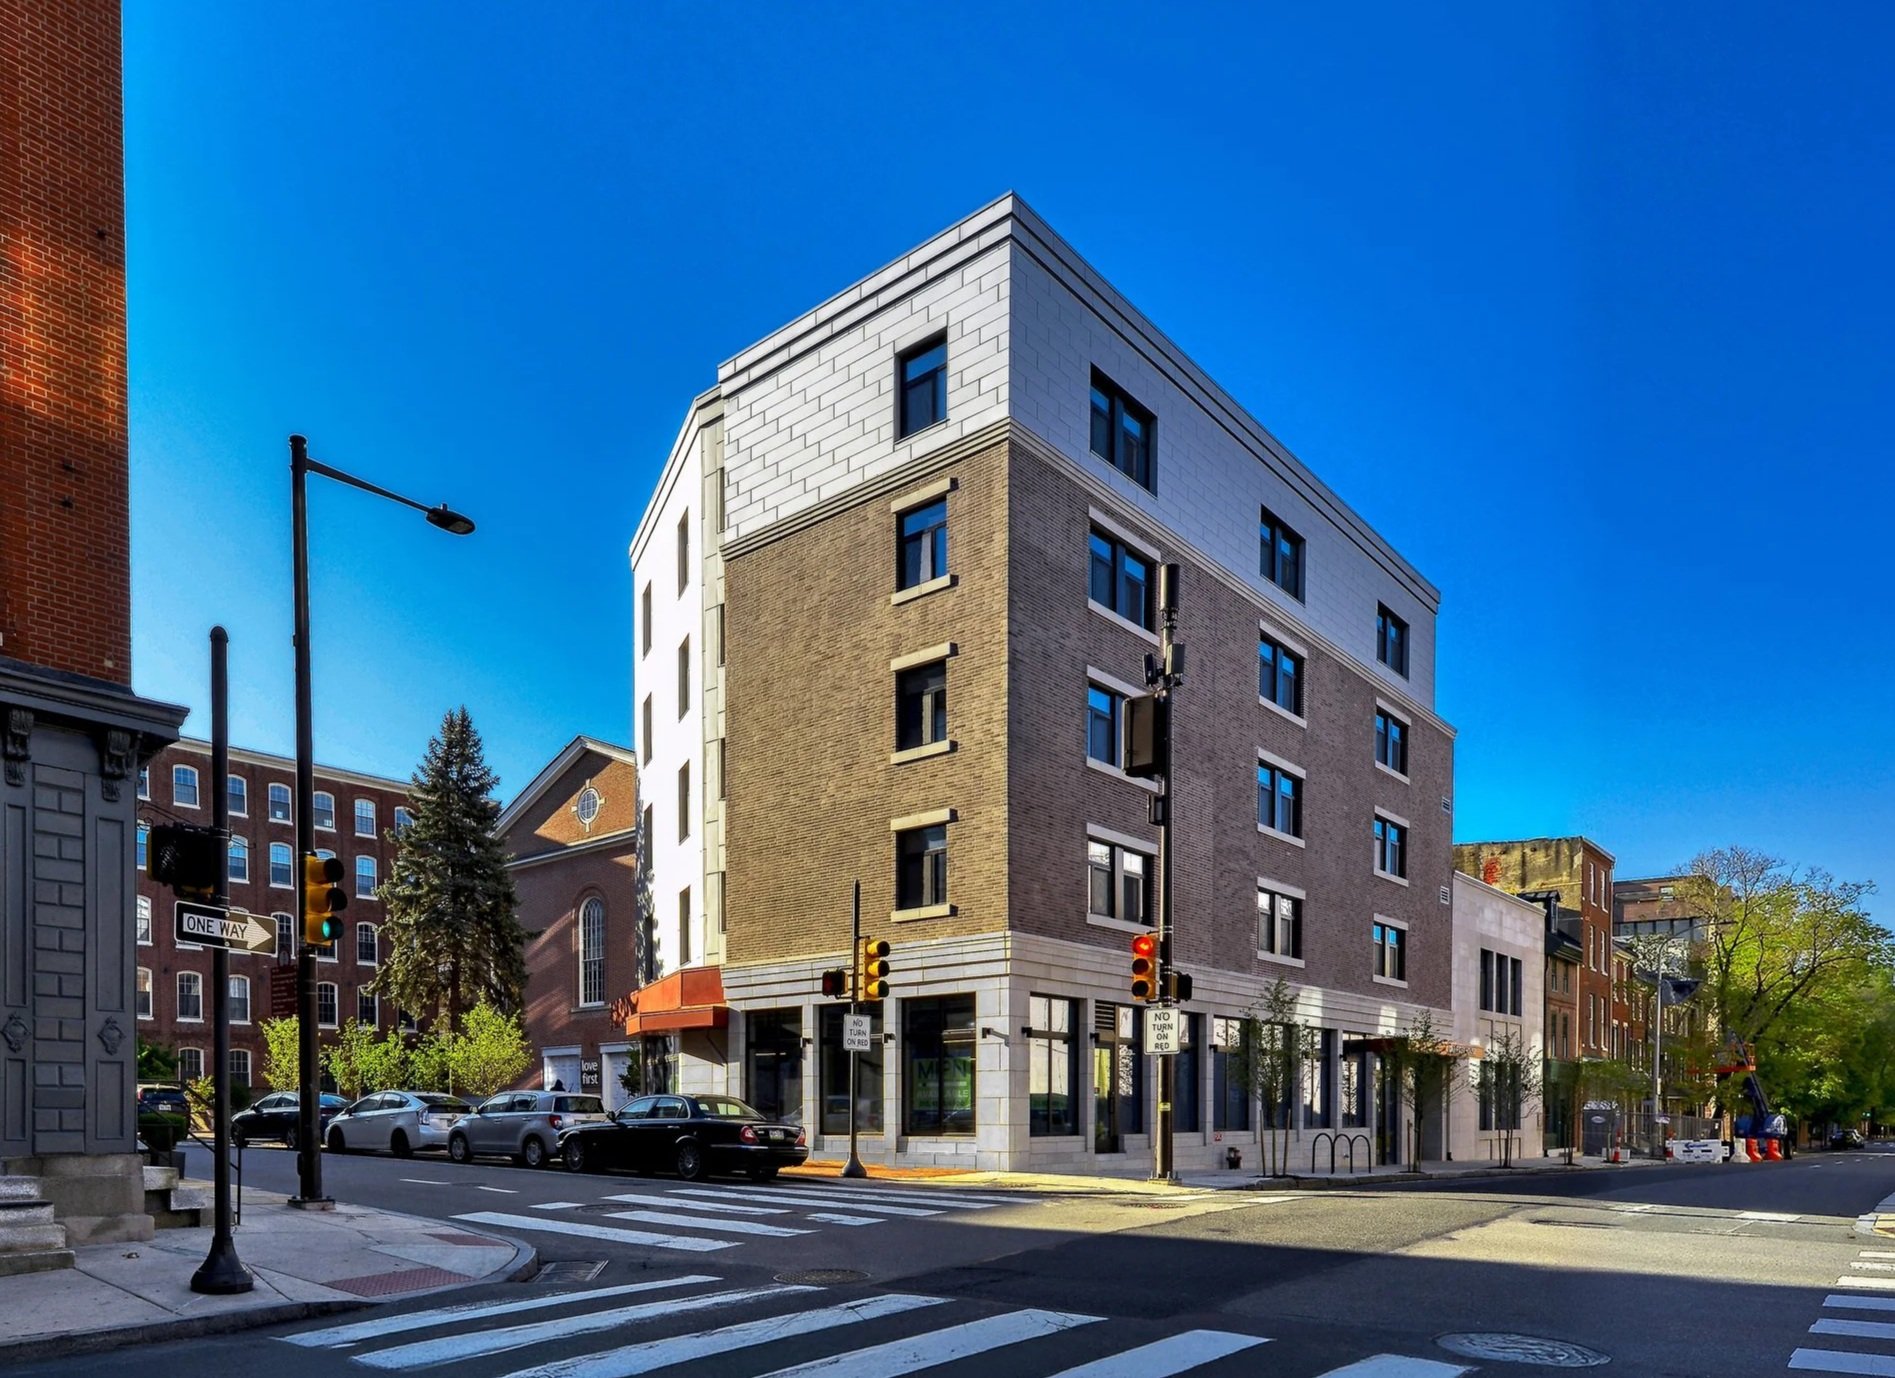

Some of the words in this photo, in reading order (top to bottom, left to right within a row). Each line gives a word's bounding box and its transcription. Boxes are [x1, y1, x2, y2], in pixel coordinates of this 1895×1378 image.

[187, 916, 214, 934] ONE
[220, 921, 247, 939] WAY
[1154, 1012, 1170, 1021] NO
[853, 1019, 863, 1027] NO
[1152, 1023, 1173, 1031] TURN
[857, 1038, 868, 1046] RED
[1154, 1042, 1170, 1050] RED
[582, 1060, 598, 1071] love
[582, 1073, 598, 1084] first
